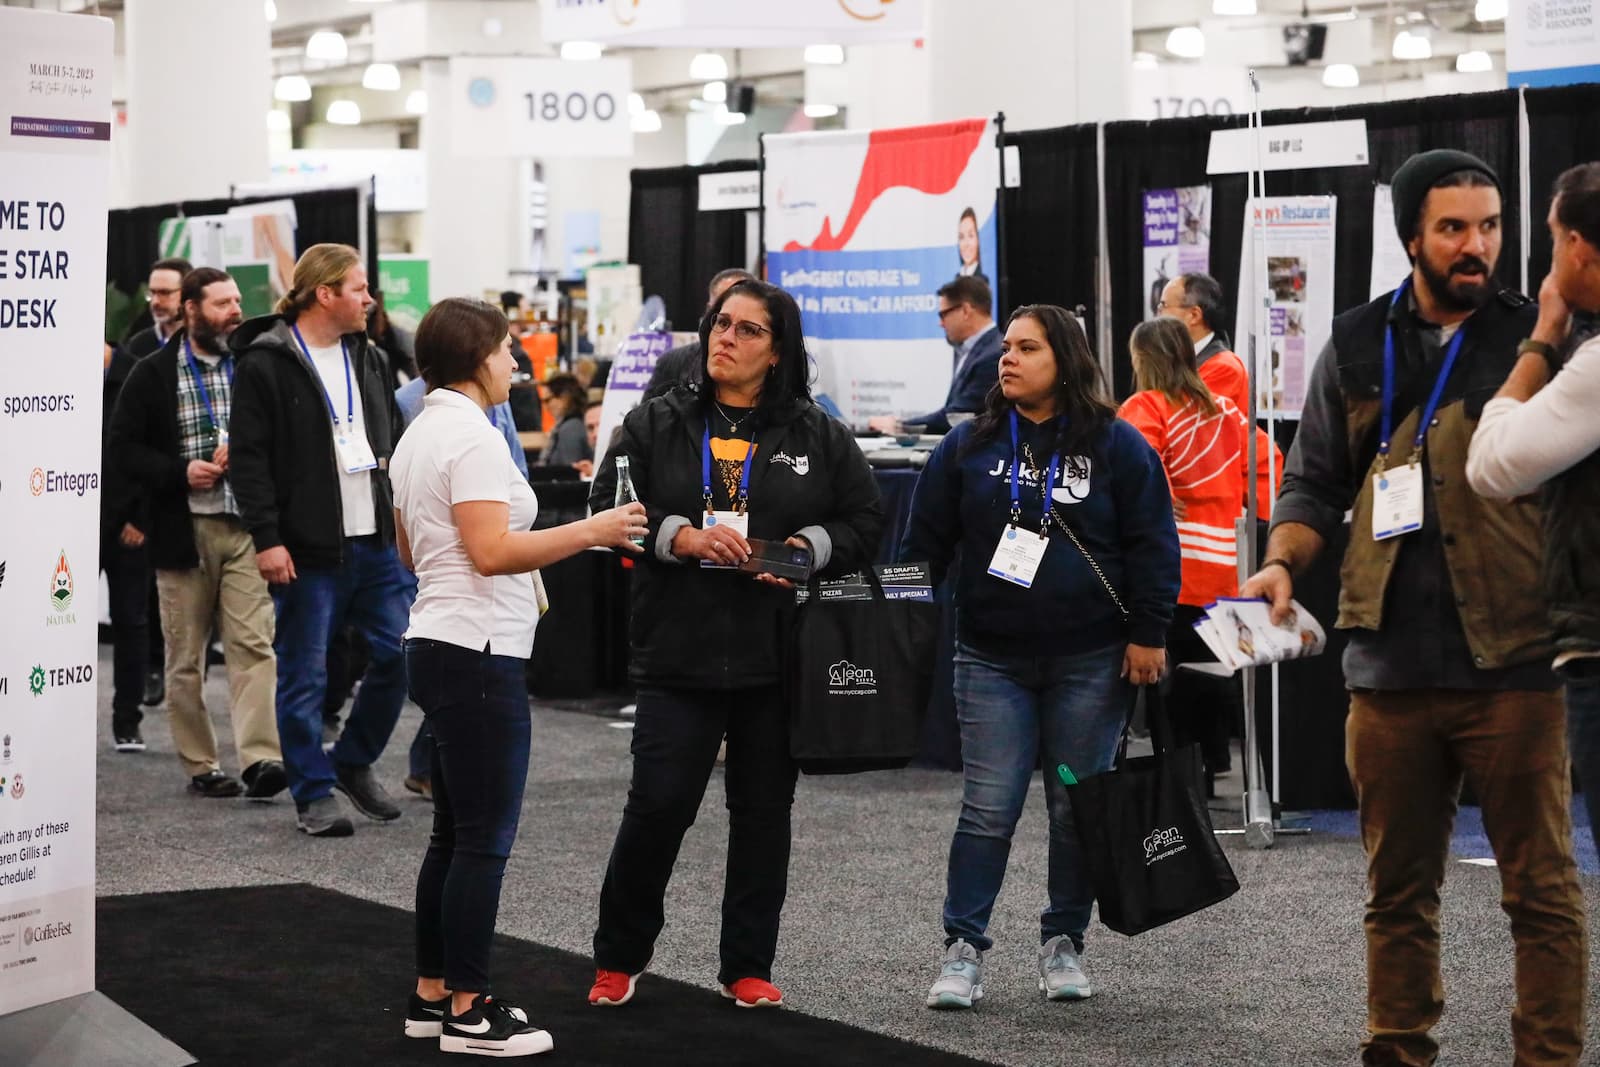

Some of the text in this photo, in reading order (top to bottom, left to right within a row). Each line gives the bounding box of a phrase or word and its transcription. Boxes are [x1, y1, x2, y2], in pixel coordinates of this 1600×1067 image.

[29, 63, 60, 79] MARCH
[76, 67, 94, 80] 2023
[523, 92, 615, 121] 1800
[1153, 97, 1232, 119] 1700
[37, 201, 65, 231] TO
[1282, 204, 1331, 220] Restaurant
[15, 250, 69, 280] STAR
[0, 299, 57, 328] DESK
[4, 394, 74, 418] sponsors:
[46, 470, 98, 497] Entegra
[1067, 467, 1089, 480] 58
[893, 565, 919, 575] DRAFTS
[822, 589, 843, 597] PIZZAS
[900, 590, 929, 598] SPECIALS
[46, 614, 77, 627] NATURA
[50, 664, 93, 687] TENZO
[17, 829, 33, 843] any
[35, 823, 44, 839] of
[46, 820, 70, 836] these
[19, 847, 41, 862] Gillis
[42, 843, 52, 856] at
